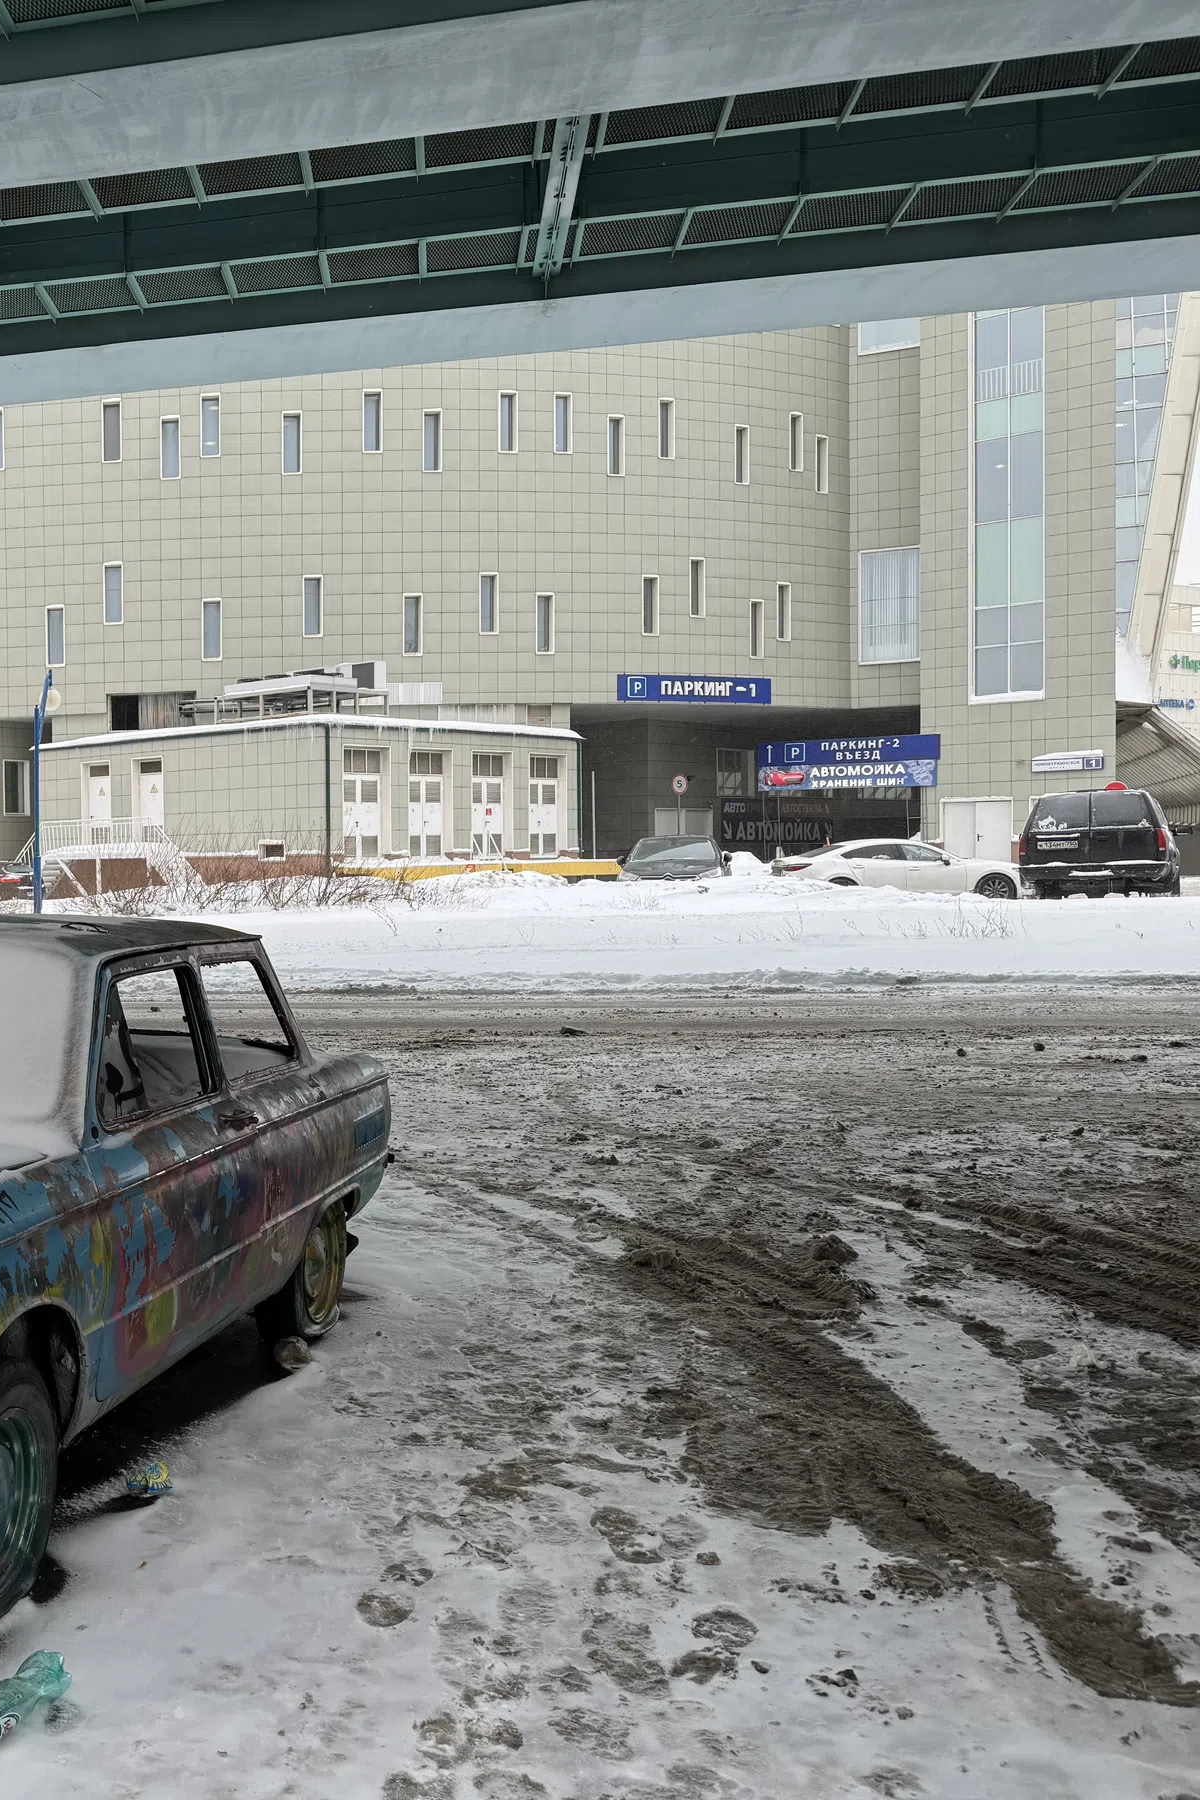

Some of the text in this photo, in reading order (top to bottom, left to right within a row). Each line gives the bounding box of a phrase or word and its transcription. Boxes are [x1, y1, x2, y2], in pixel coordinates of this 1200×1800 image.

[821, 738, 900, 751] ПАРКИНГ-2
[836, 750, 881, 761] ВЪЕЗД
[809, 763, 906, 779] АВТОМОЙКА
[677, 780, 683, 788] 5
[811, 777, 905, 789] ХРАНЕНИЕ ШИН
[781, 803, 821, 814] АВТОСТЕКЛА
[735, 818, 821, 841] АВТОМОЙКА
